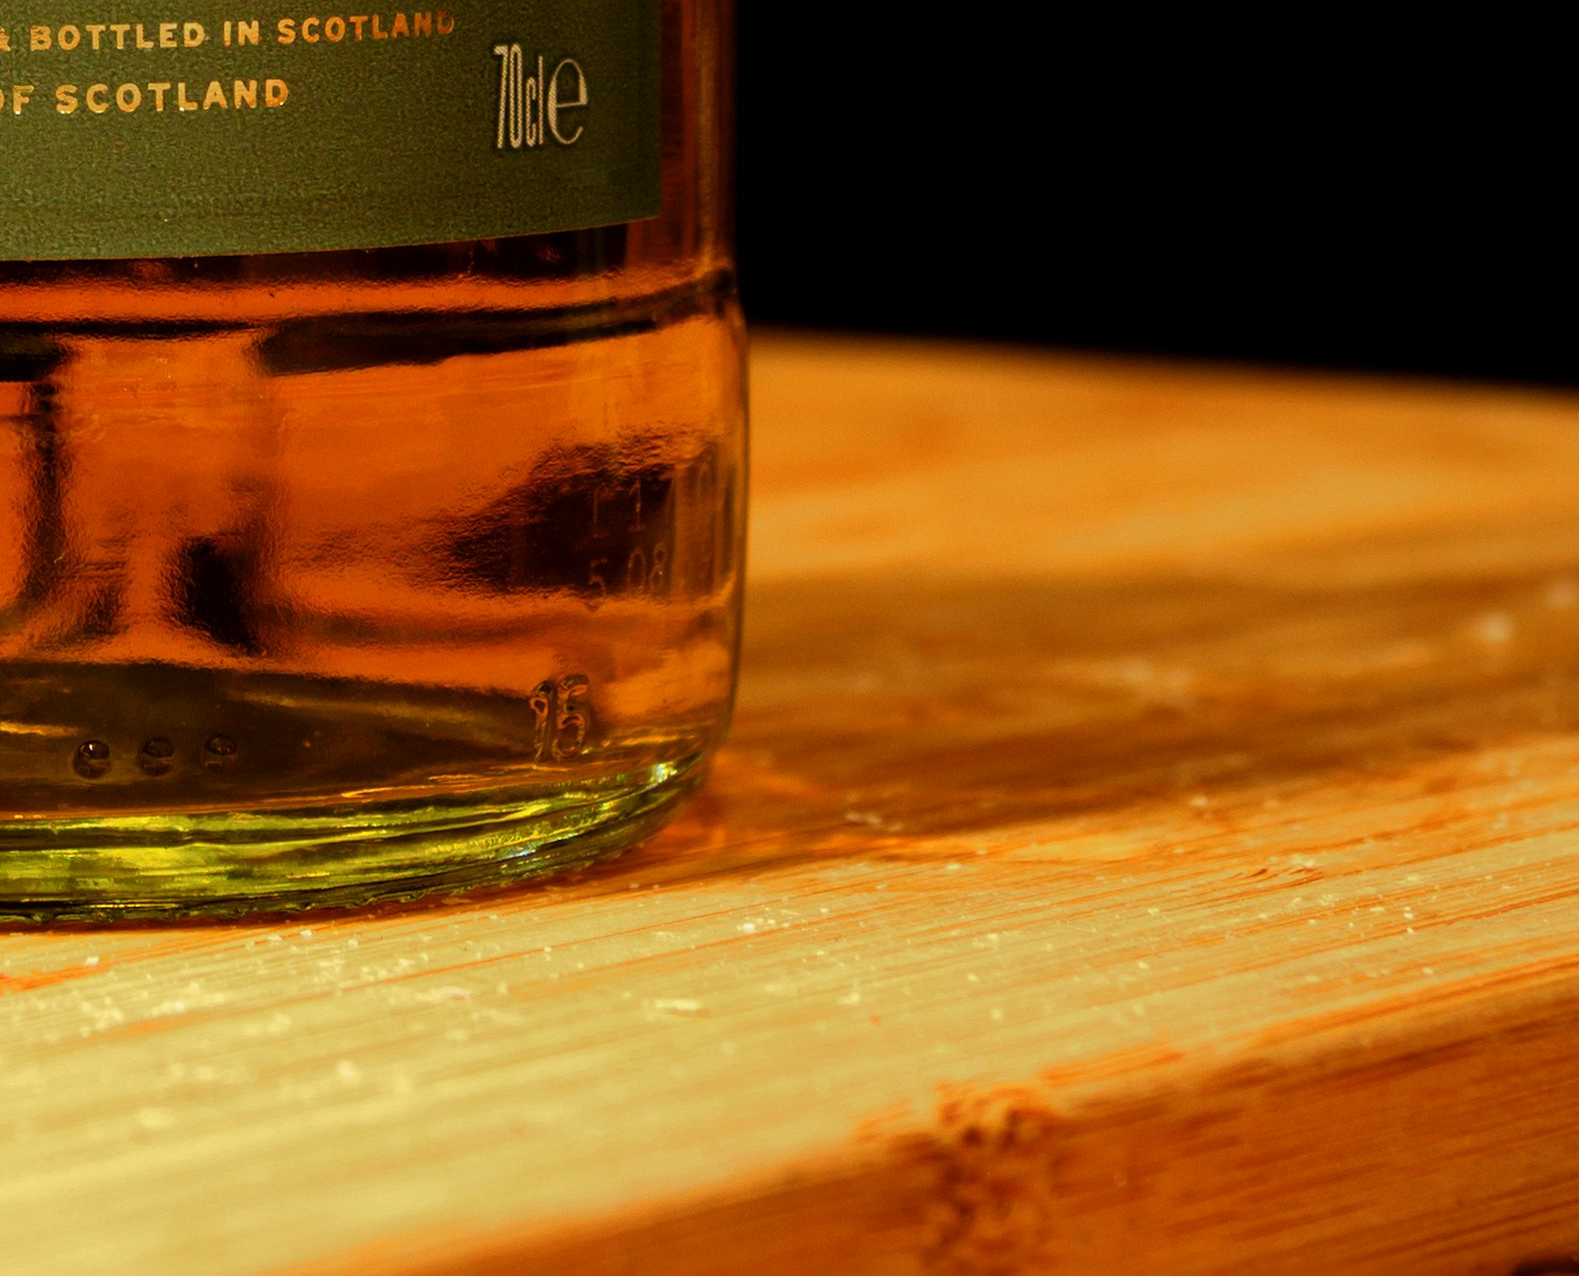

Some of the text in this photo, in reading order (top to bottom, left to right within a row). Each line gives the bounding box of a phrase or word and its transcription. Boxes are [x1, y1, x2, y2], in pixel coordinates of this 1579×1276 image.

[29, 22, 207, 52] BOTTLED
[223, 19, 261, 48] IN
[276, 10, 456, 46] SCOTLAND
[54, 78, 291, 115] SCOTLAND
